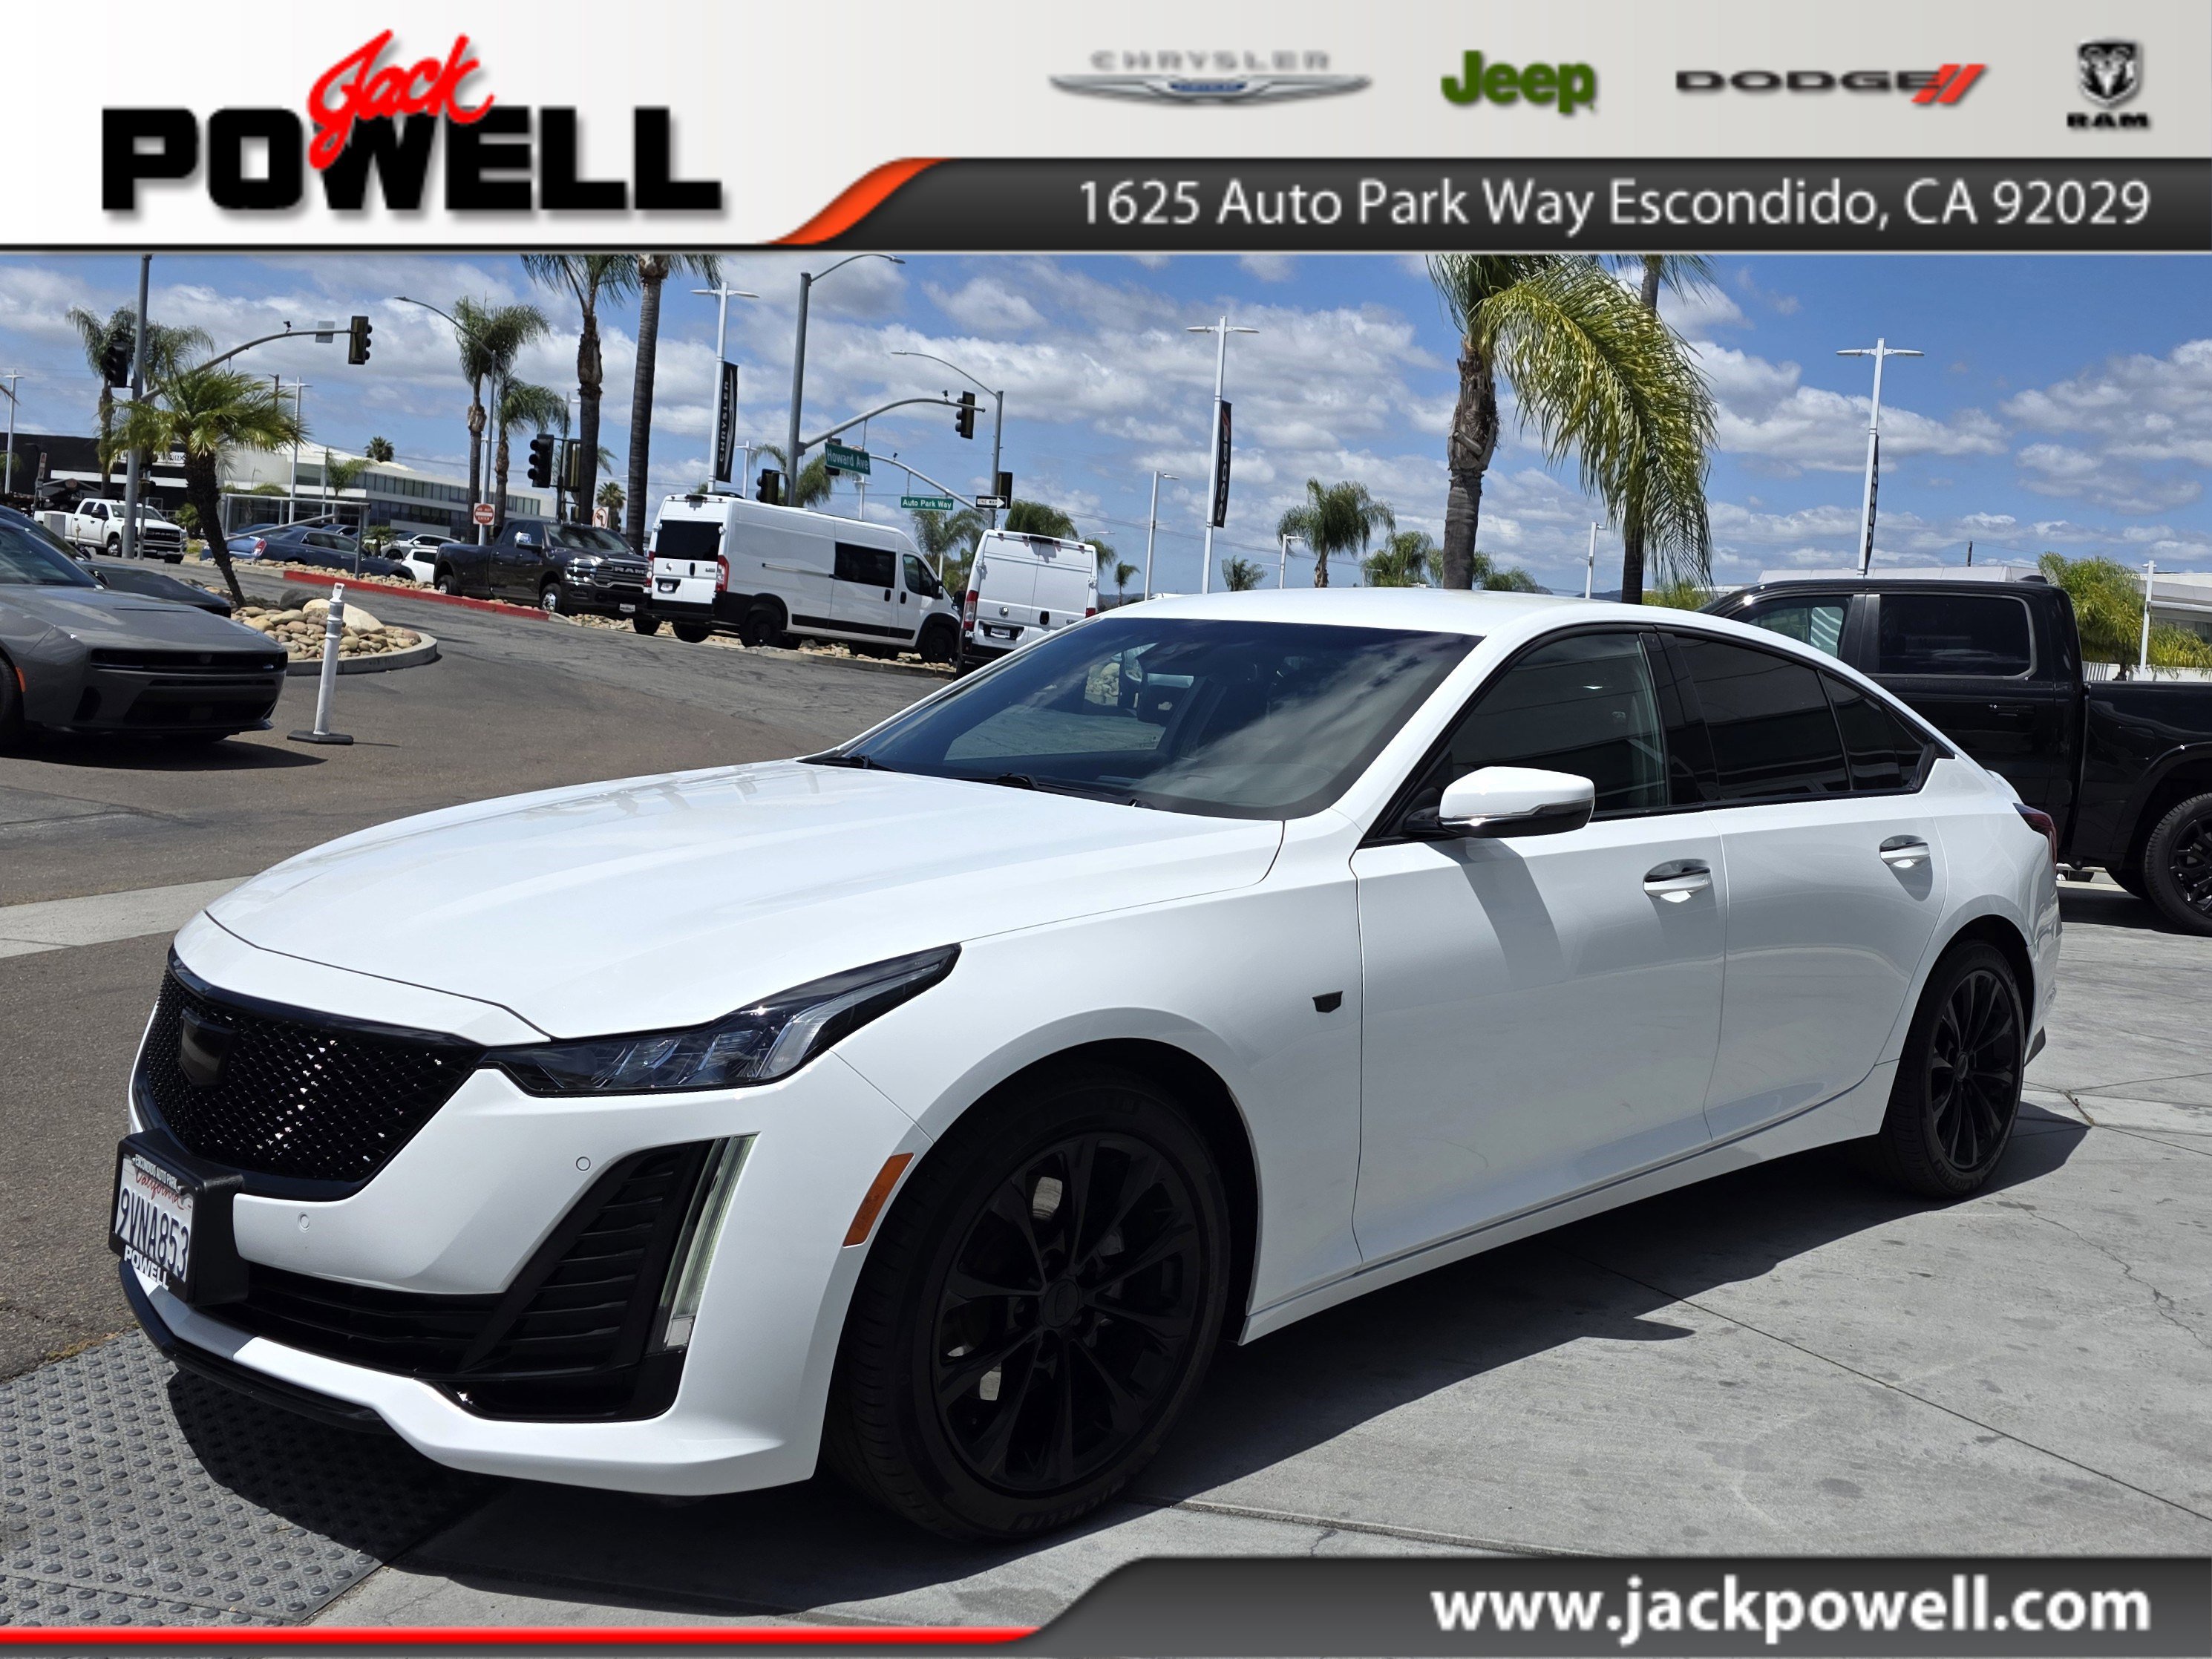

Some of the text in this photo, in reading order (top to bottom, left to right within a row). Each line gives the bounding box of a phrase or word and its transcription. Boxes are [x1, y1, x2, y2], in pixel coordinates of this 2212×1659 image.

[719, 381, 730, 462] CHRYSLER
[826, 448, 869, 471] Howard Ave
[938, 500, 952, 509] Way
[614, 566, 645, 575] RAM
[117, 1188, 189, 1279] 9VNA853
[124, 1244, 169, 1291] POWELL
